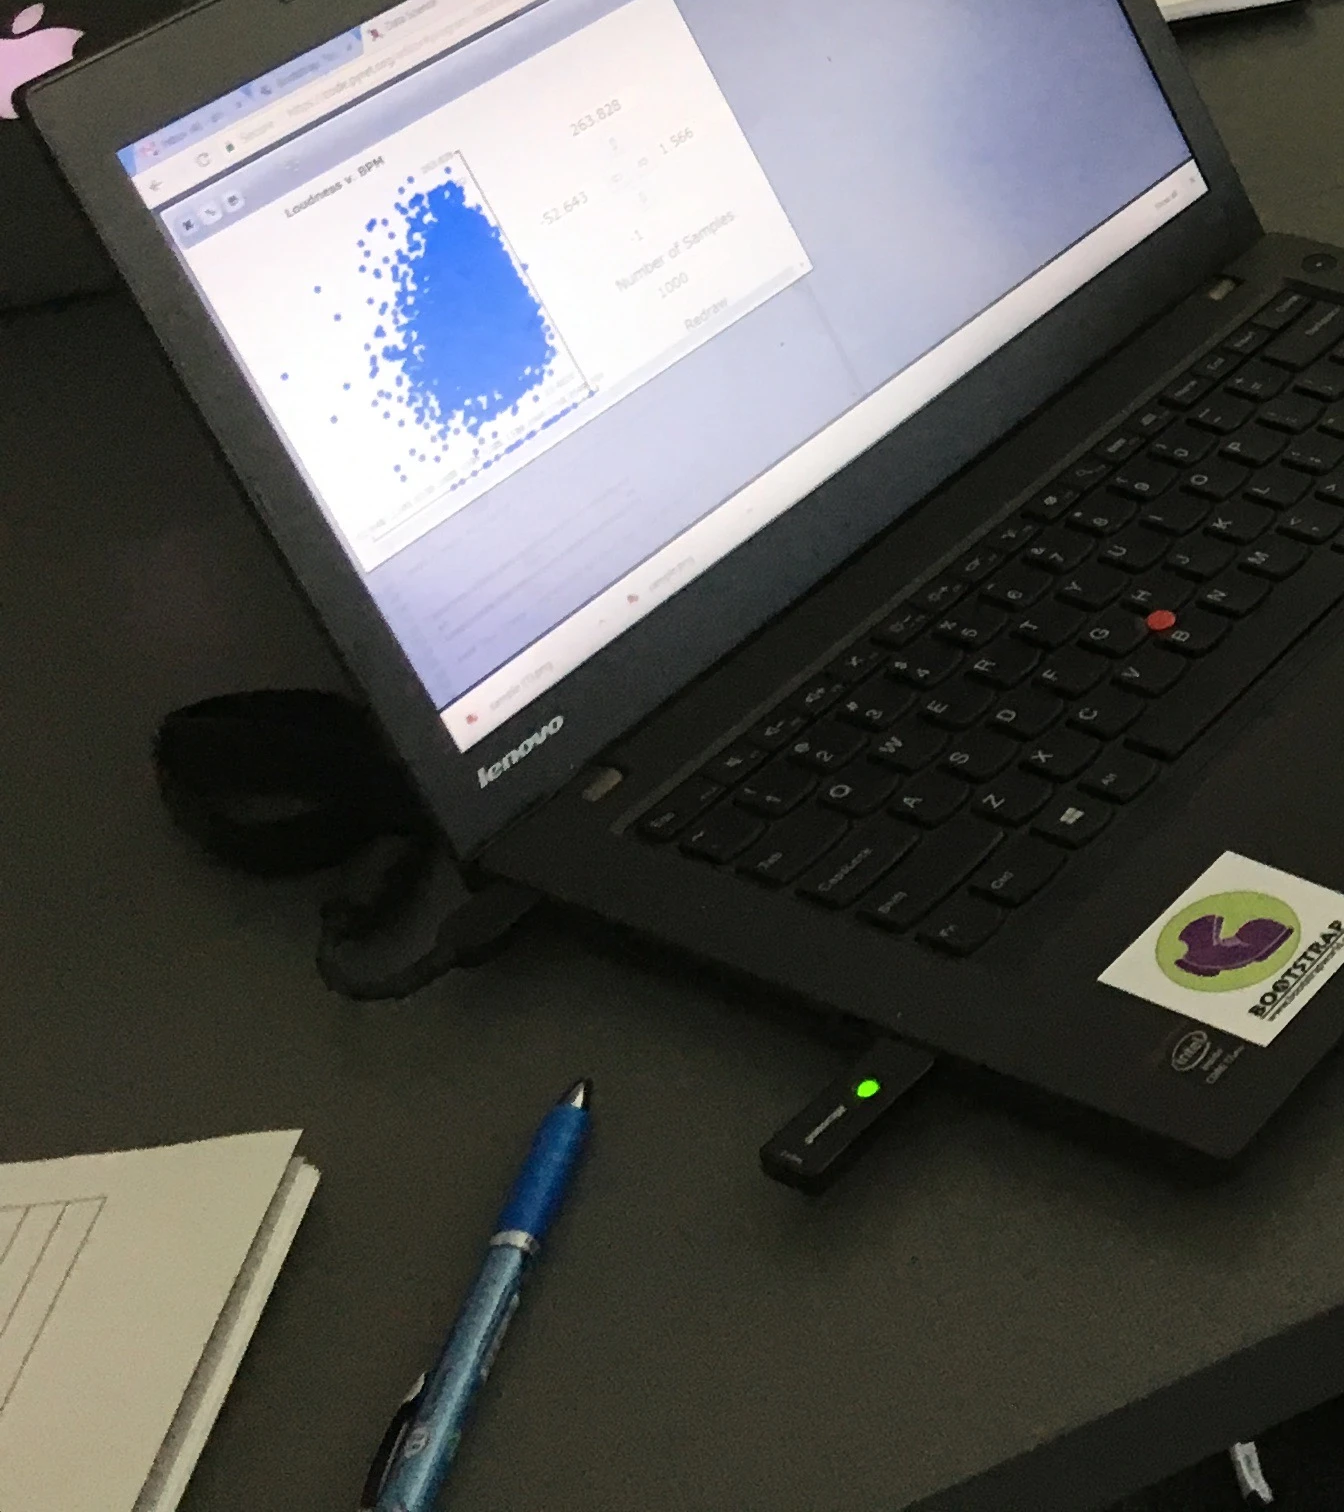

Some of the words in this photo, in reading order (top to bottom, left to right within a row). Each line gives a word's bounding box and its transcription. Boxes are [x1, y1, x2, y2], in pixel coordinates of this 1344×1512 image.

[569, 98, 622, 137] 263.828
[658, 126, 695, 156] 1.566
[284, 180, 344, 219] Loudness
[357, 155, 386, 178] BPM
[540, 190, 589, 227] -52.643
[614, 254, 666, 293] Number
[668, 241, 682, 260] of
[681, 208, 736, 251] Samples
[658, 271, 690, 300] 1000
[684, 296, 730, 331] Redraw
[1227, 442, 1240, 452] P
[1191, 475, 1208, 485] O
[1212, 518, 1232, 529] K
[1049, 552, 1063, 562] 7
[1108, 545, 1126, 557] U
[1176, 554, 1189, 564] J
[1247, 551, 1269, 564] M
[1065, 581, 1081, 591] Y
[1132, 590, 1151, 601] H
[1207, 589, 1226, 601] N
[1020, 620, 1038, 630] T
[961, 628, 977, 637] 5
[1089, 628, 1109, 639] G
[1171, 630, 1190, 642] B
[974, 659, 995, 671] R
[917, 668, 930, 677] 4
[1042, 669, 1057, 681] F
[1122, 667, 1140, 677] V
[927, 700, 948, 713] E
[866, 709, 882, 719] 3
[996, 709, 1016, 722] D
[1079, 708, 1097, 720] C
[879, 736, 902, 753] W
[476, 715, 564, 789] lenovo
[816, 751, 833, 762] 2
[949, 752, 969, 764] S
[1032, 750, 1053, 762] X
[829, 785, 851, 798] Q
[903, 797, 922, 808] A
[982, 794, 1004, 808] Z
[1248, 919, 1342, 1017] BOOTSTRAP
